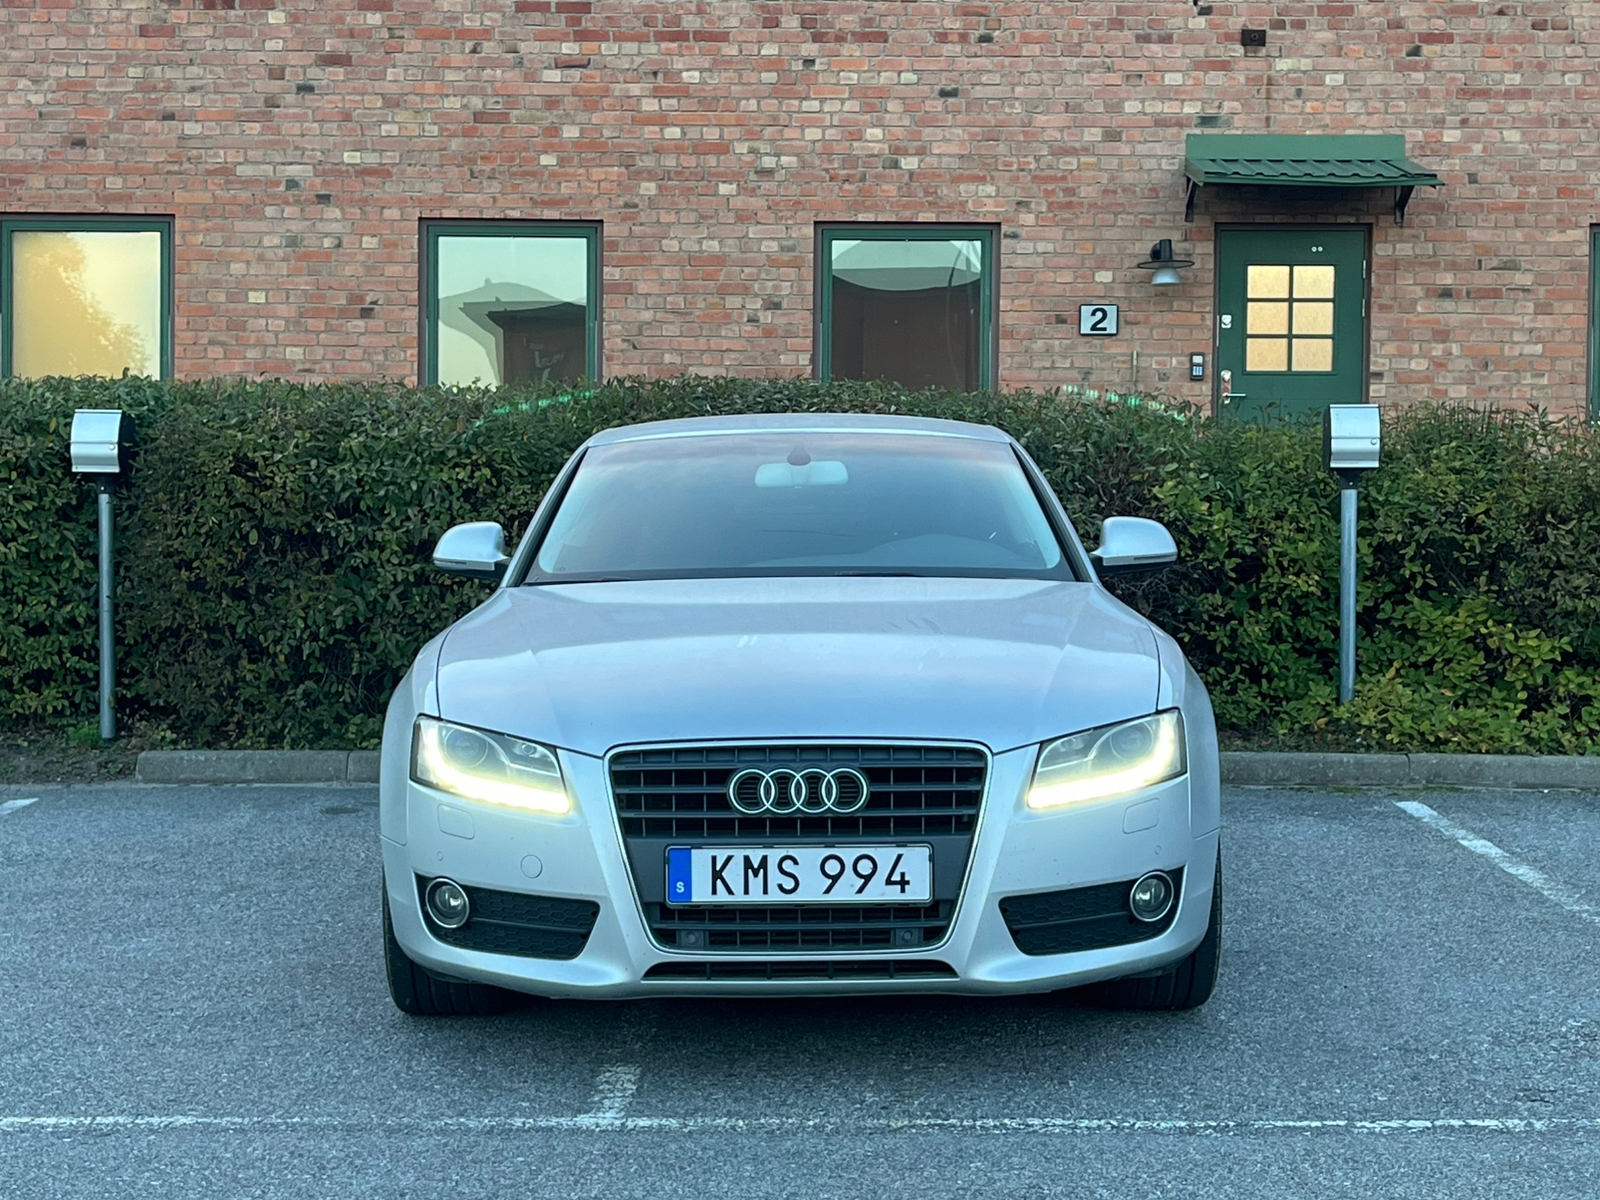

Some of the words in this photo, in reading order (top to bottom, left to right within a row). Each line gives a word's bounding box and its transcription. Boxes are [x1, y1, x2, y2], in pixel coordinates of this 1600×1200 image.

[1090, 307, 1108, 332] 2
[675, 881, 685, 893] S
[710, 854, 800, 896] KMS
[819, 853, 911, 895] 994
